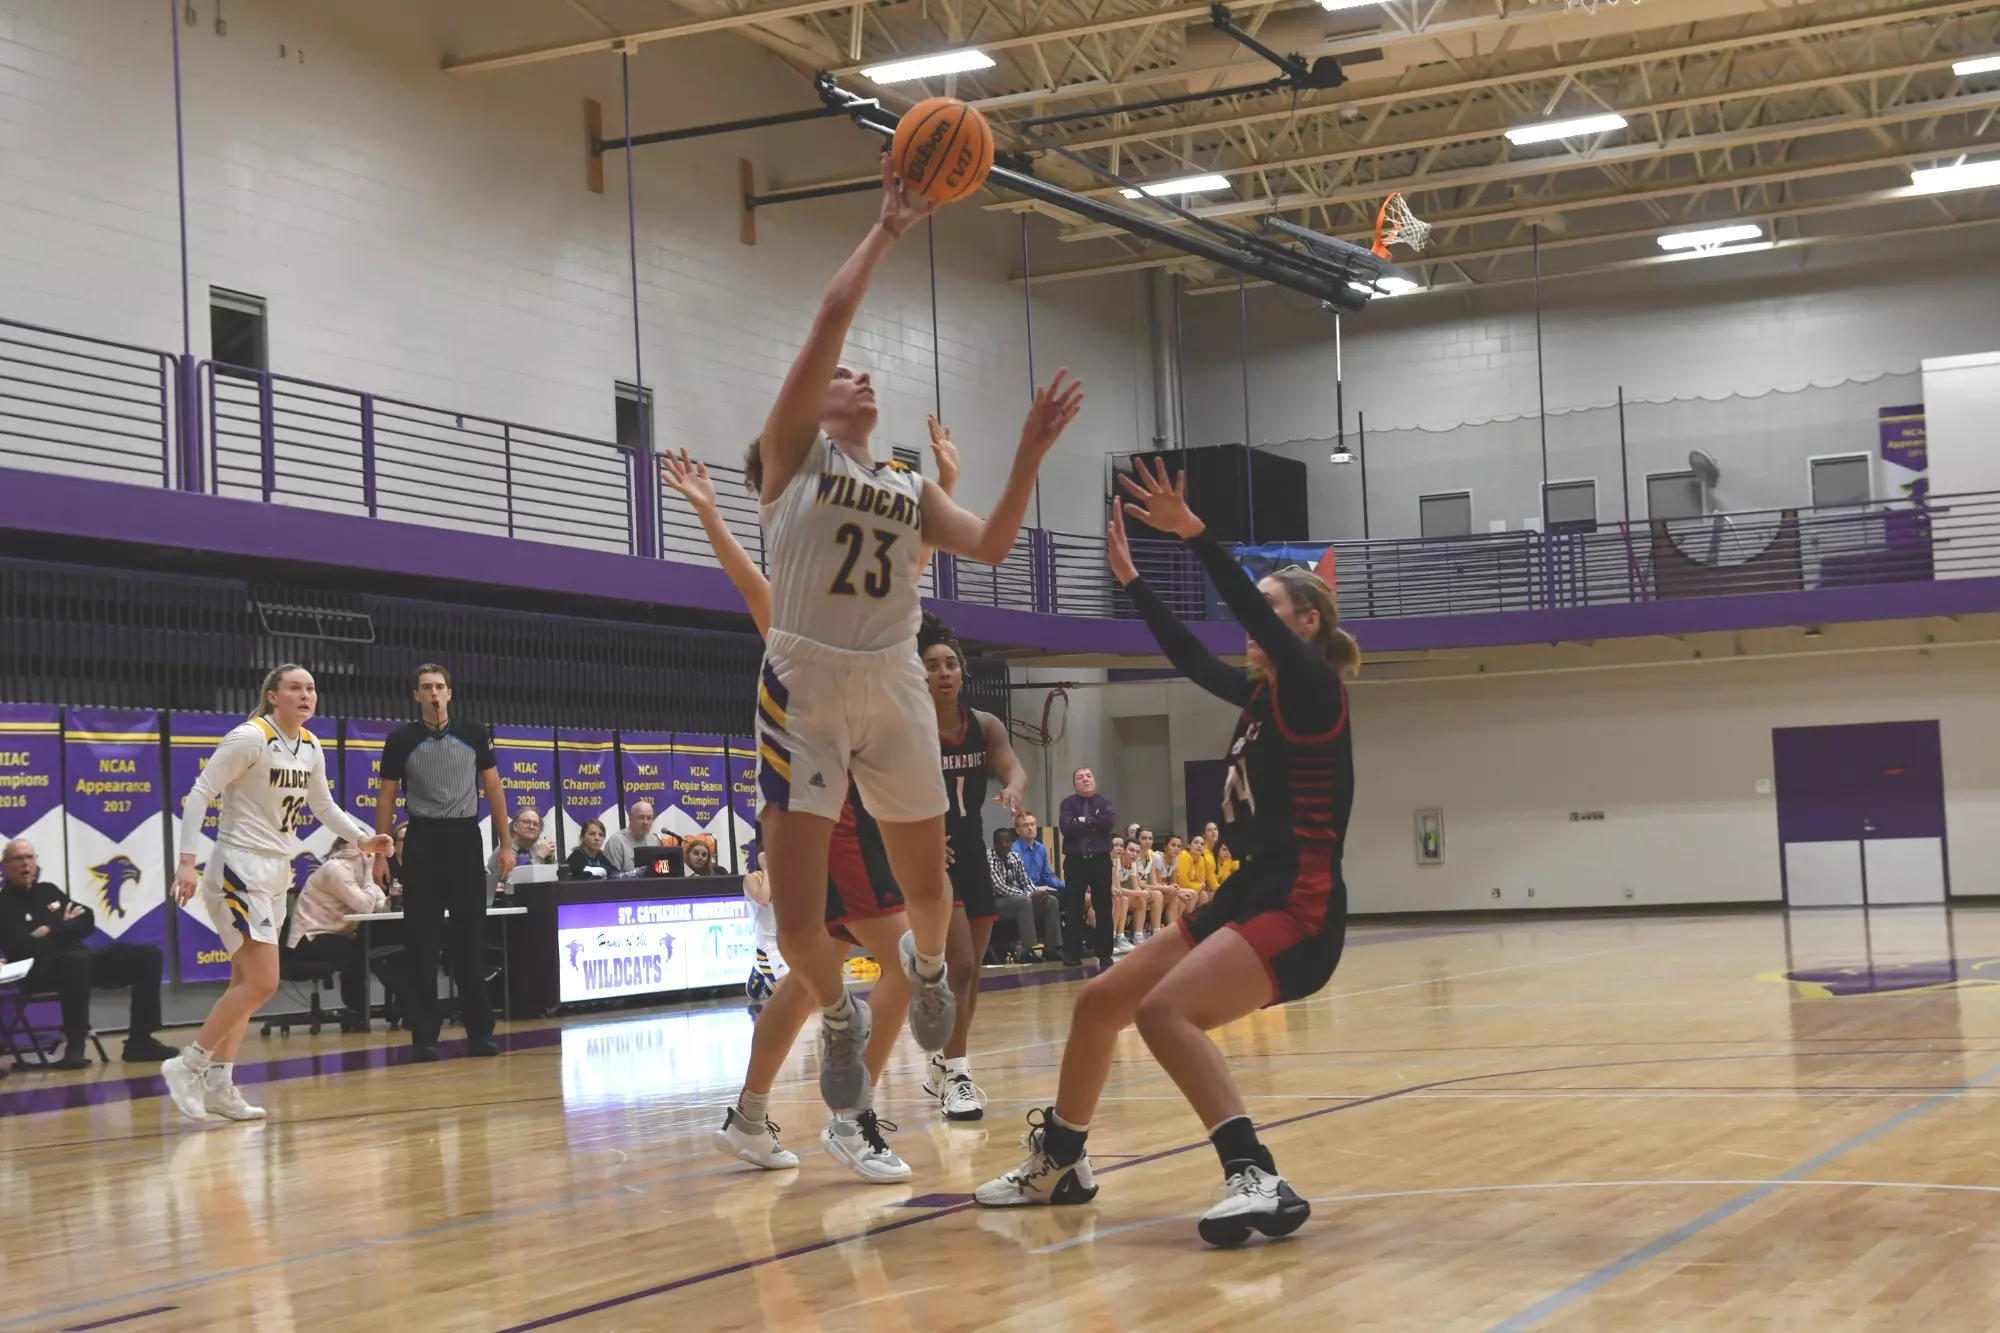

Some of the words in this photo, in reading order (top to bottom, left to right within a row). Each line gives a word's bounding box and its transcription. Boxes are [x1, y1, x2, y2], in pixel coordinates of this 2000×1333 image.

[828, 522, 900, 599] 23
[99, 759, 136, 773] NCAA
[513, 762, 538, 774] MIAC
[690, 766, 710, 777] MIAC
[75, 778, 152, 796] Appearance
[501, 778, 551, 791] Champions
[673, 780, 700, 793] Regular
[701, 781, 723, 792] Season
[517, 795, 536, 806] 2020
[681, 794, 720, 807] Champions
[955, 776, 967, 817] 1
[103, 800, 132, 813] 2017
[583, 954, 662, 991] WILDCATS
